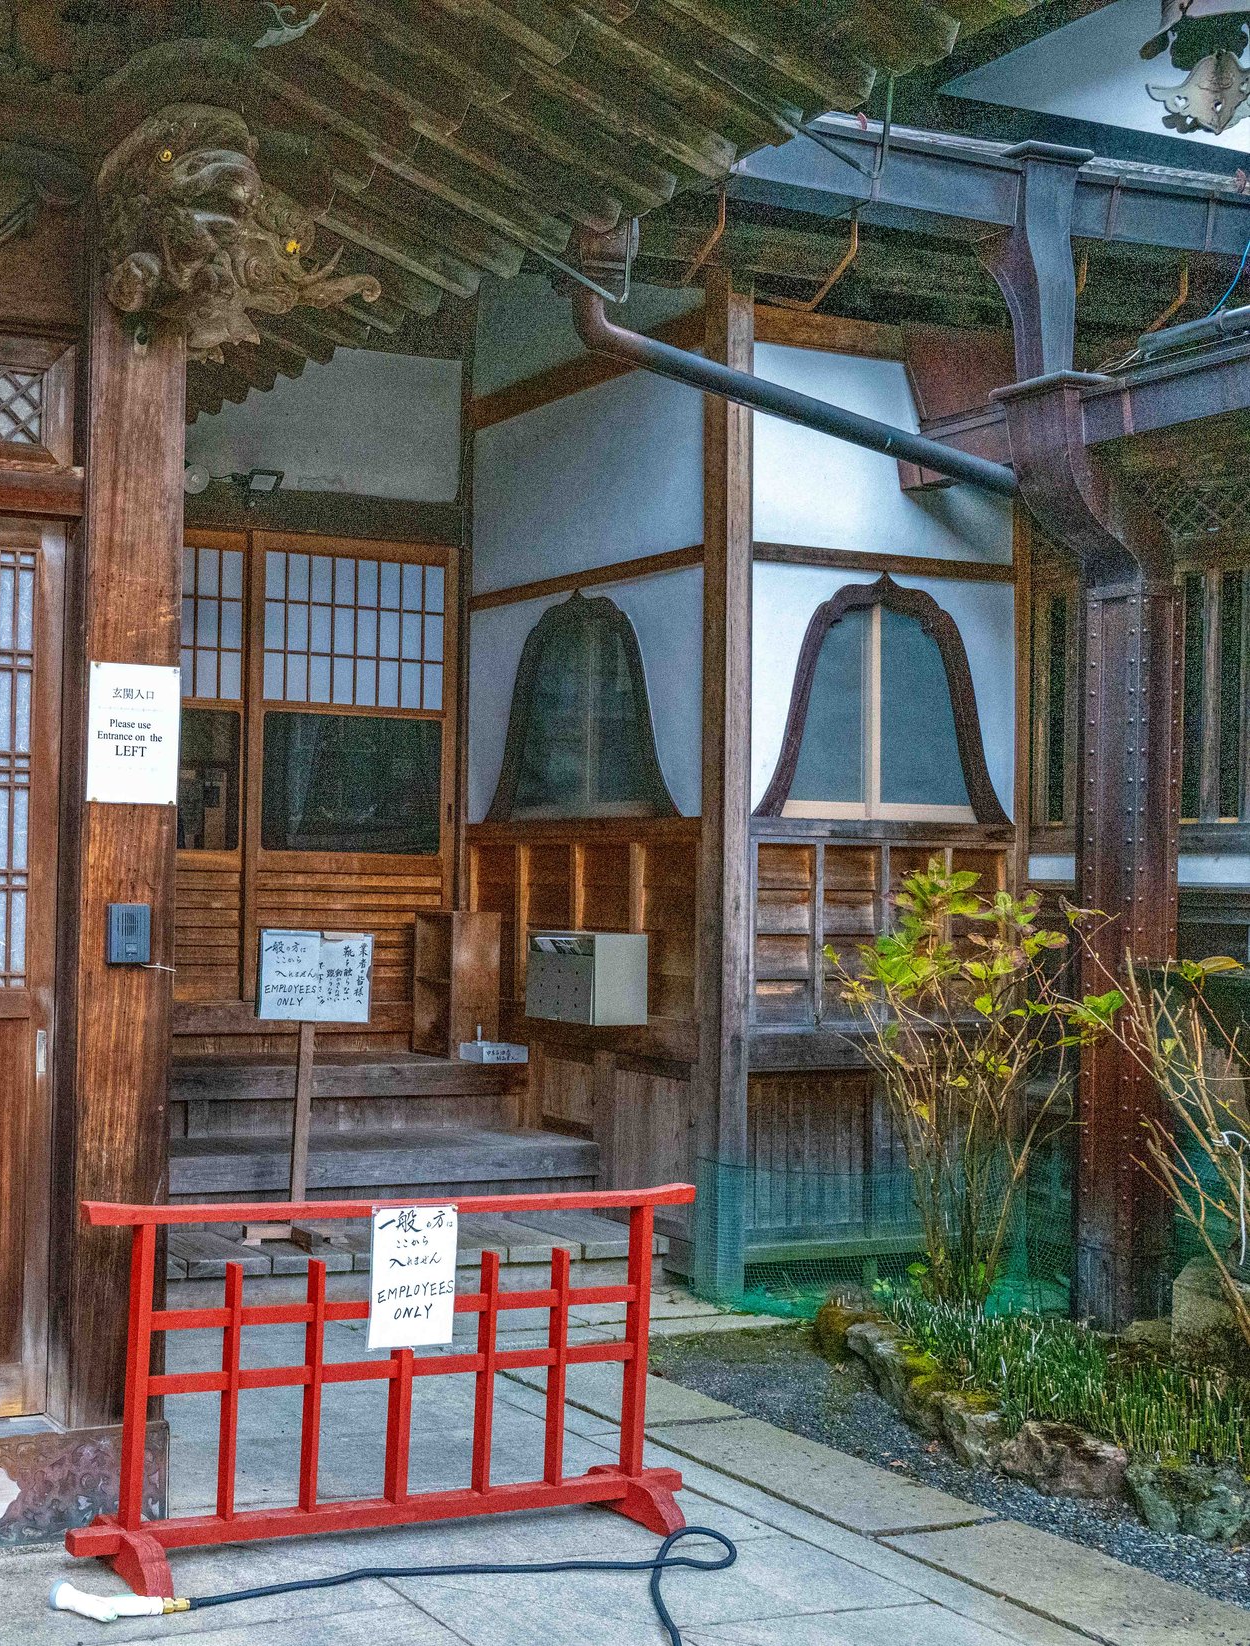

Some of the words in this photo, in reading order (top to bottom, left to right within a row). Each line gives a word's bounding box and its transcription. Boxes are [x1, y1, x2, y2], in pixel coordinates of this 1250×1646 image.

[112, 687, 155, 700] 玄関入口
[109, 718, 136, 729] Please
[137, 722, 151, 730] use
[97, 730, 133, 741] Entrance
[134, 733, 146, 742] on
[149, 733, 163, 742] the
[115, 745, 148, 757] LEFT
[264, 984, 317, 994] EMPLOYEES
[276, 997, 304, 1007] ONLY
[378, 1209, 454, 1233] 一般の方は
[396, 1235, 430, 1249] ここから
[389, 1251, 442, 1269] 入れません
[377, 1279, 455, 1304] EMPLOYEES
[393, 1303, 433, 1320] ONLY
